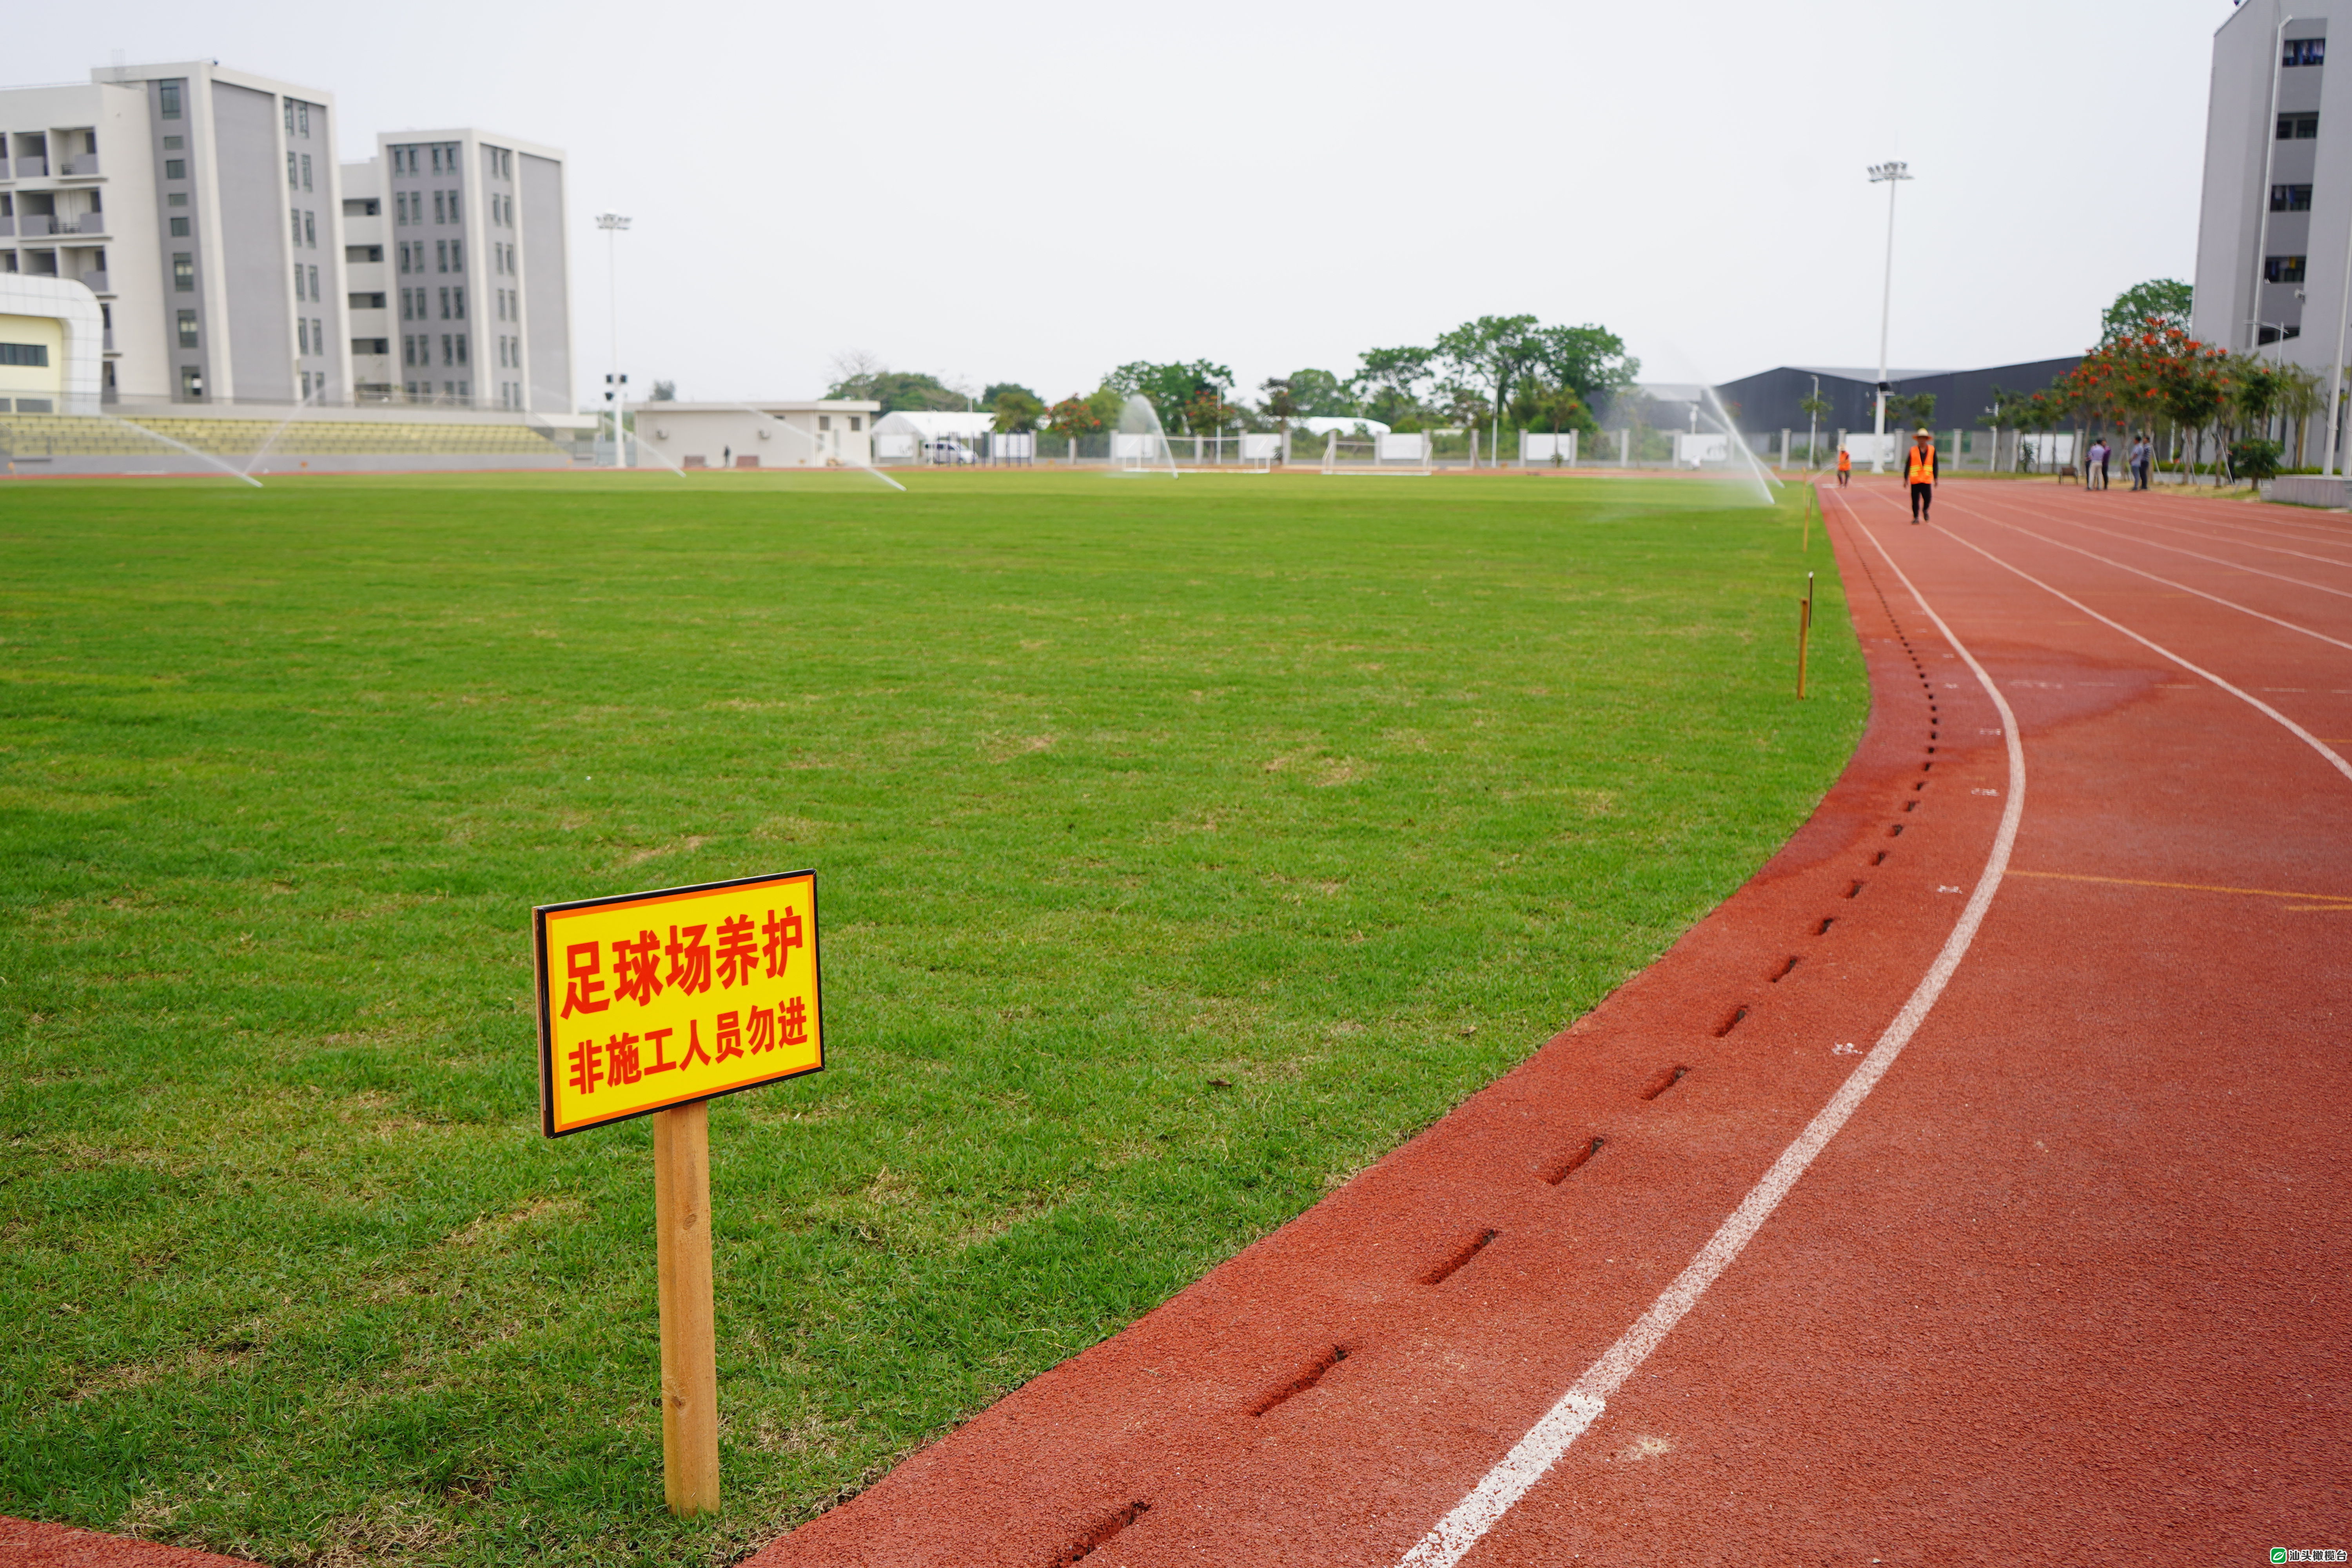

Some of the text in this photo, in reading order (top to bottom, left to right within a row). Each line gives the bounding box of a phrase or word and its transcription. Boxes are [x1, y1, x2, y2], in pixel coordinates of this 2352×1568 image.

[561, 906, 803, 1020] 足球场养护
[568, 996, 808, 1095] 非施工人员勿进
